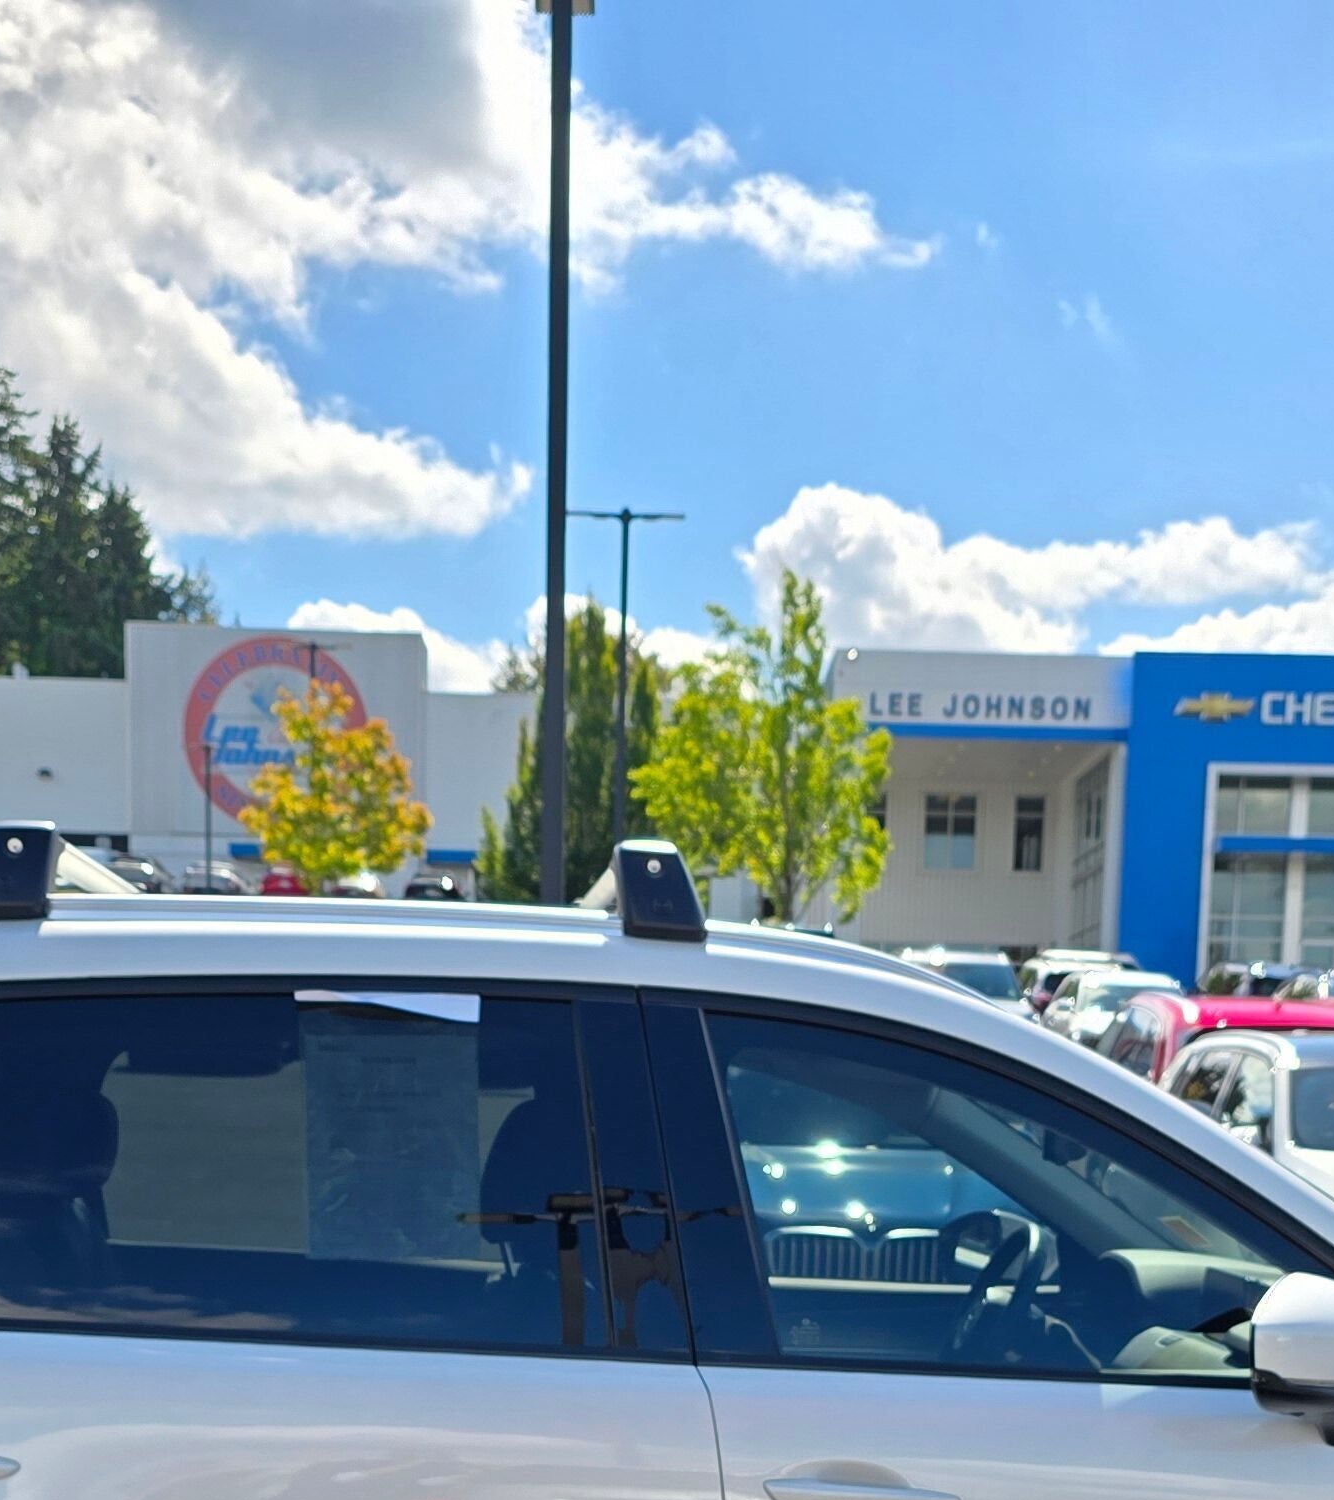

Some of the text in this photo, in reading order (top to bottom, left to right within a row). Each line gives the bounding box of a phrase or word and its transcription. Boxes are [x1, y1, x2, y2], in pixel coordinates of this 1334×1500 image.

[869, 692, 1092, 721] LEE JOHNSON
[213, 742, 296, 766] Johns
